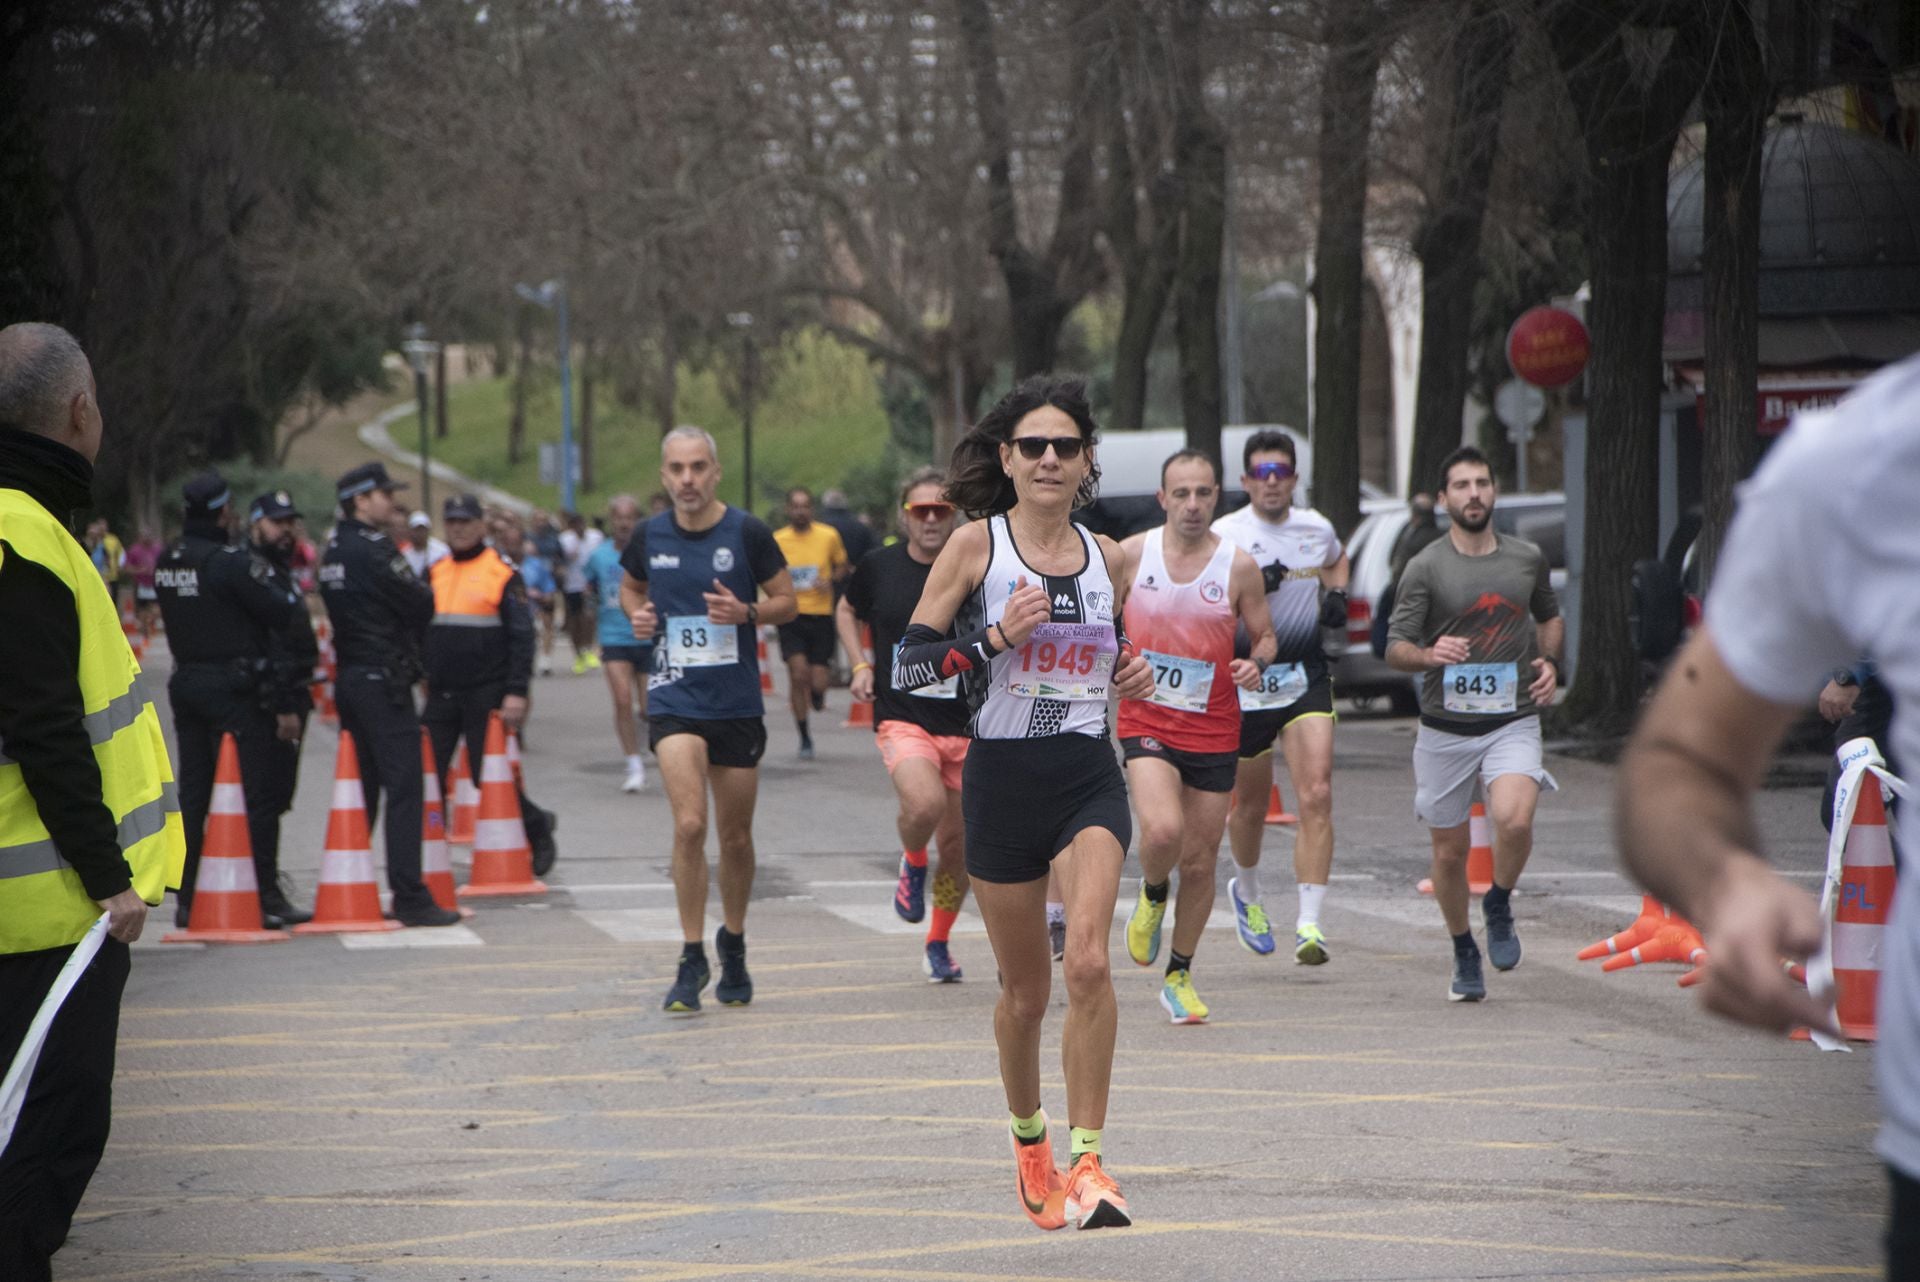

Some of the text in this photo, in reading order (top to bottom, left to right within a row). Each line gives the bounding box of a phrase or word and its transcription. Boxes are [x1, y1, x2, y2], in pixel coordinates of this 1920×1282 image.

[681, 627, 708, 648] 83
[1034, 629, 1061, 637] VUELTA
[1063, 629, 1072, 637] AL
[1073, 630, 1105, 638] BALUARTE
[1018, 641, 1098, 676] 1945
[1156, 664, 1183, 689] 70
[1455, 674, 1497, 695] 843
[1087, 686, 1105, 695] HOY
[1843, 881, 1874, 910] PL
